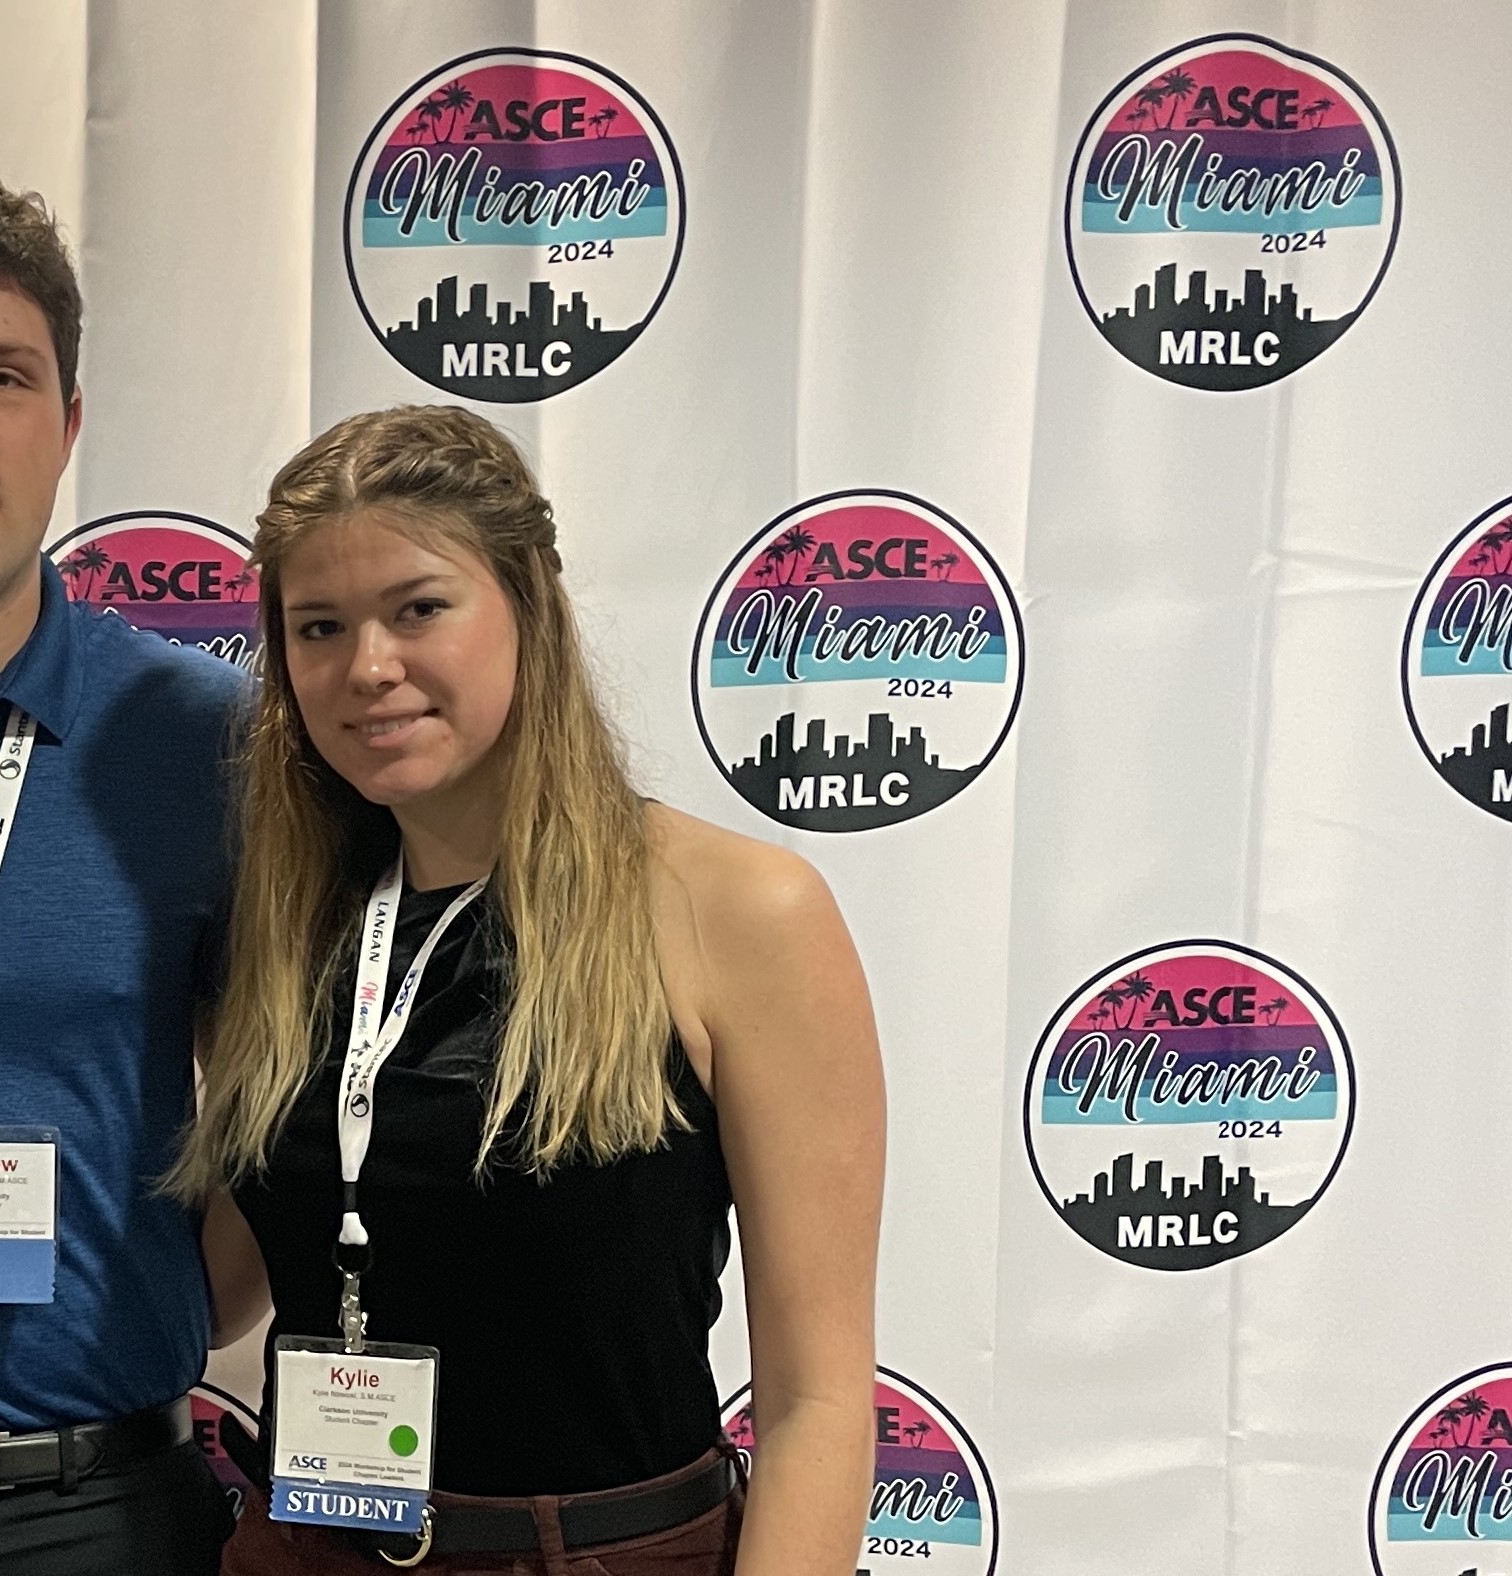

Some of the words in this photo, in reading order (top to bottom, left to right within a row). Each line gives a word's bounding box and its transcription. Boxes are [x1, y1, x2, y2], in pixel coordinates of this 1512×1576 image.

[464, 98, 586, 141] ASCE
[1186, 88, 1301, 130] ASCE
[380, 147, 649, 244] Miami
[1097, 135, 1366, 230] Miami
[547, 240, 615, 265] 2024
[1260, 229, 1328, 254] 2024
[442, 342, 572, 378] MRLC
[1159, 331, 1280, 367] MRLC
[805, 537, 930, 582] ASCE
[99, 562, 221, 601] ASCE
[729, 588, 990, 681] Miami
[886, 677, 954, 700] 2024
[777, 772, 910, 810] MRLC
[369, 901, 389, 962] LANGAN
[1144, 987, 1258, 1027] ASCE
[1059, 1032, 1320, 1122] Miami
[1217, 1119, 1283, 1140] 2024
[1117, 1211, 1239, 1248] MRLC
[330, 1367, 380, 1390] Kylie
[289, 1455, 327, 1470] ASCE
[286, 1490, 409, 1522] STUDENT
[867, 1537, 931, 1559] 2024
